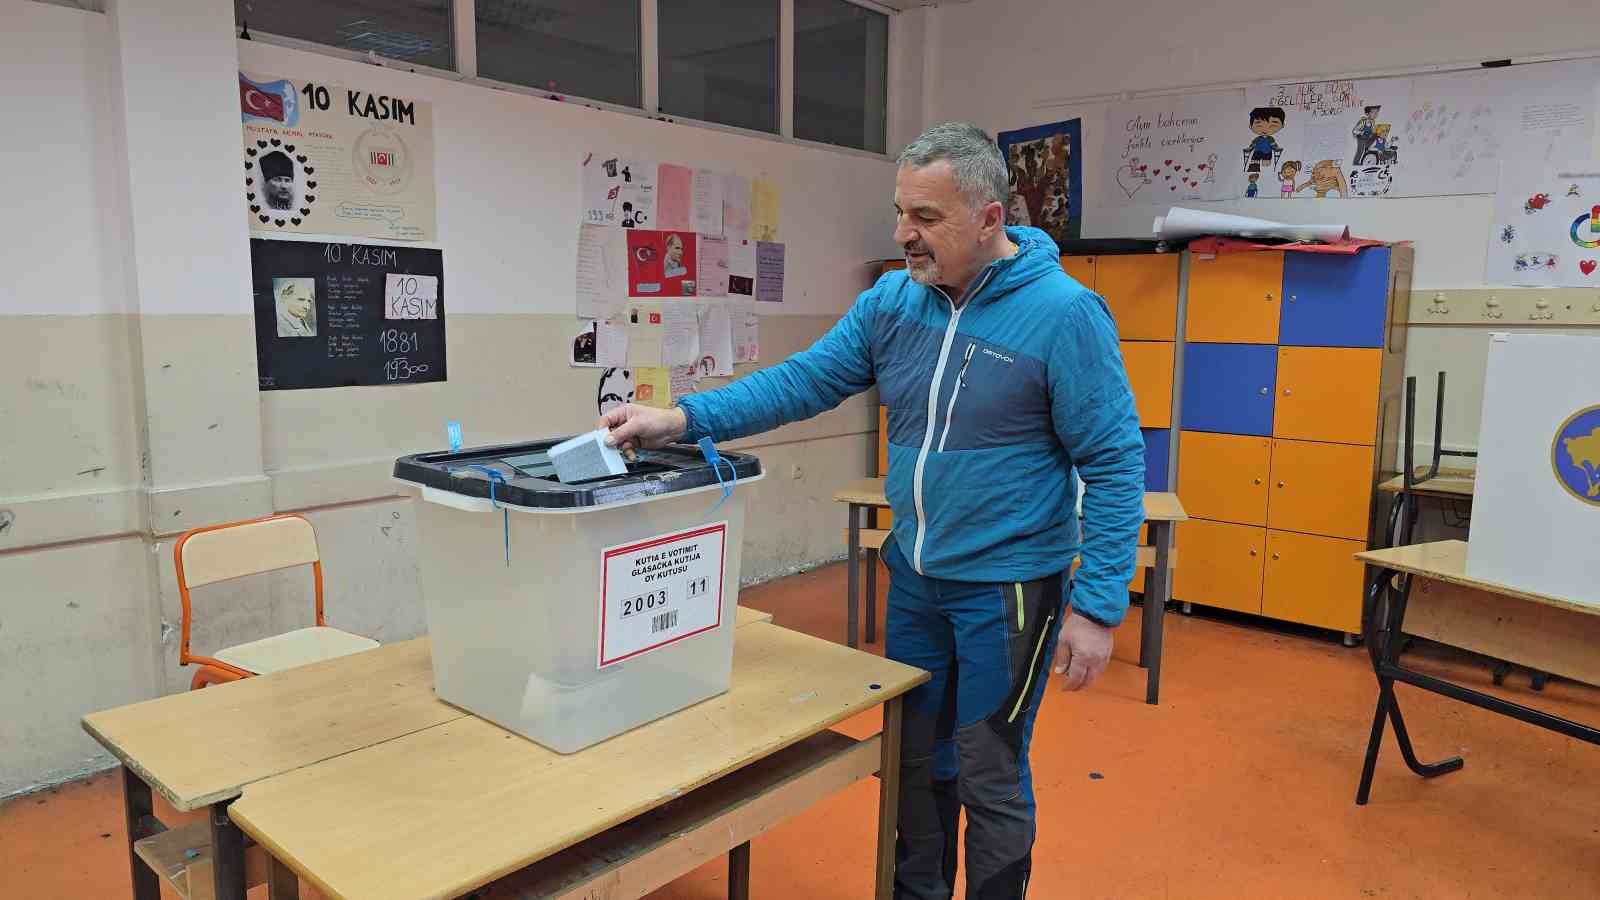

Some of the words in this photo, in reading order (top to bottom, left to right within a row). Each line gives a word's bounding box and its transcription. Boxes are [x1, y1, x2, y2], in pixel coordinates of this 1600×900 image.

[301, 83, 330, 111] 10
[347, 90, 415, 125] KASIM
[323, 243, 341, 263] 10
[351, 246, 397, 268] KASIM
[397, 277, 418, 295] 10
[391, 297, 437, 317] KASIM
[378, 328, 418, 353] 1881
[635, 554, 660, 567] KUTIA
[661, 552, 667, 560] E
[668, 544, 698, 557] VOTIMIT
[674, 552, 701, 566] KUTIJA
[644, 573, 656, 583] OY
[657, 565, 688, 579] KUTUSU
[623, 590, 667, 616] 2003
[690, 578, 706, 595] 11
